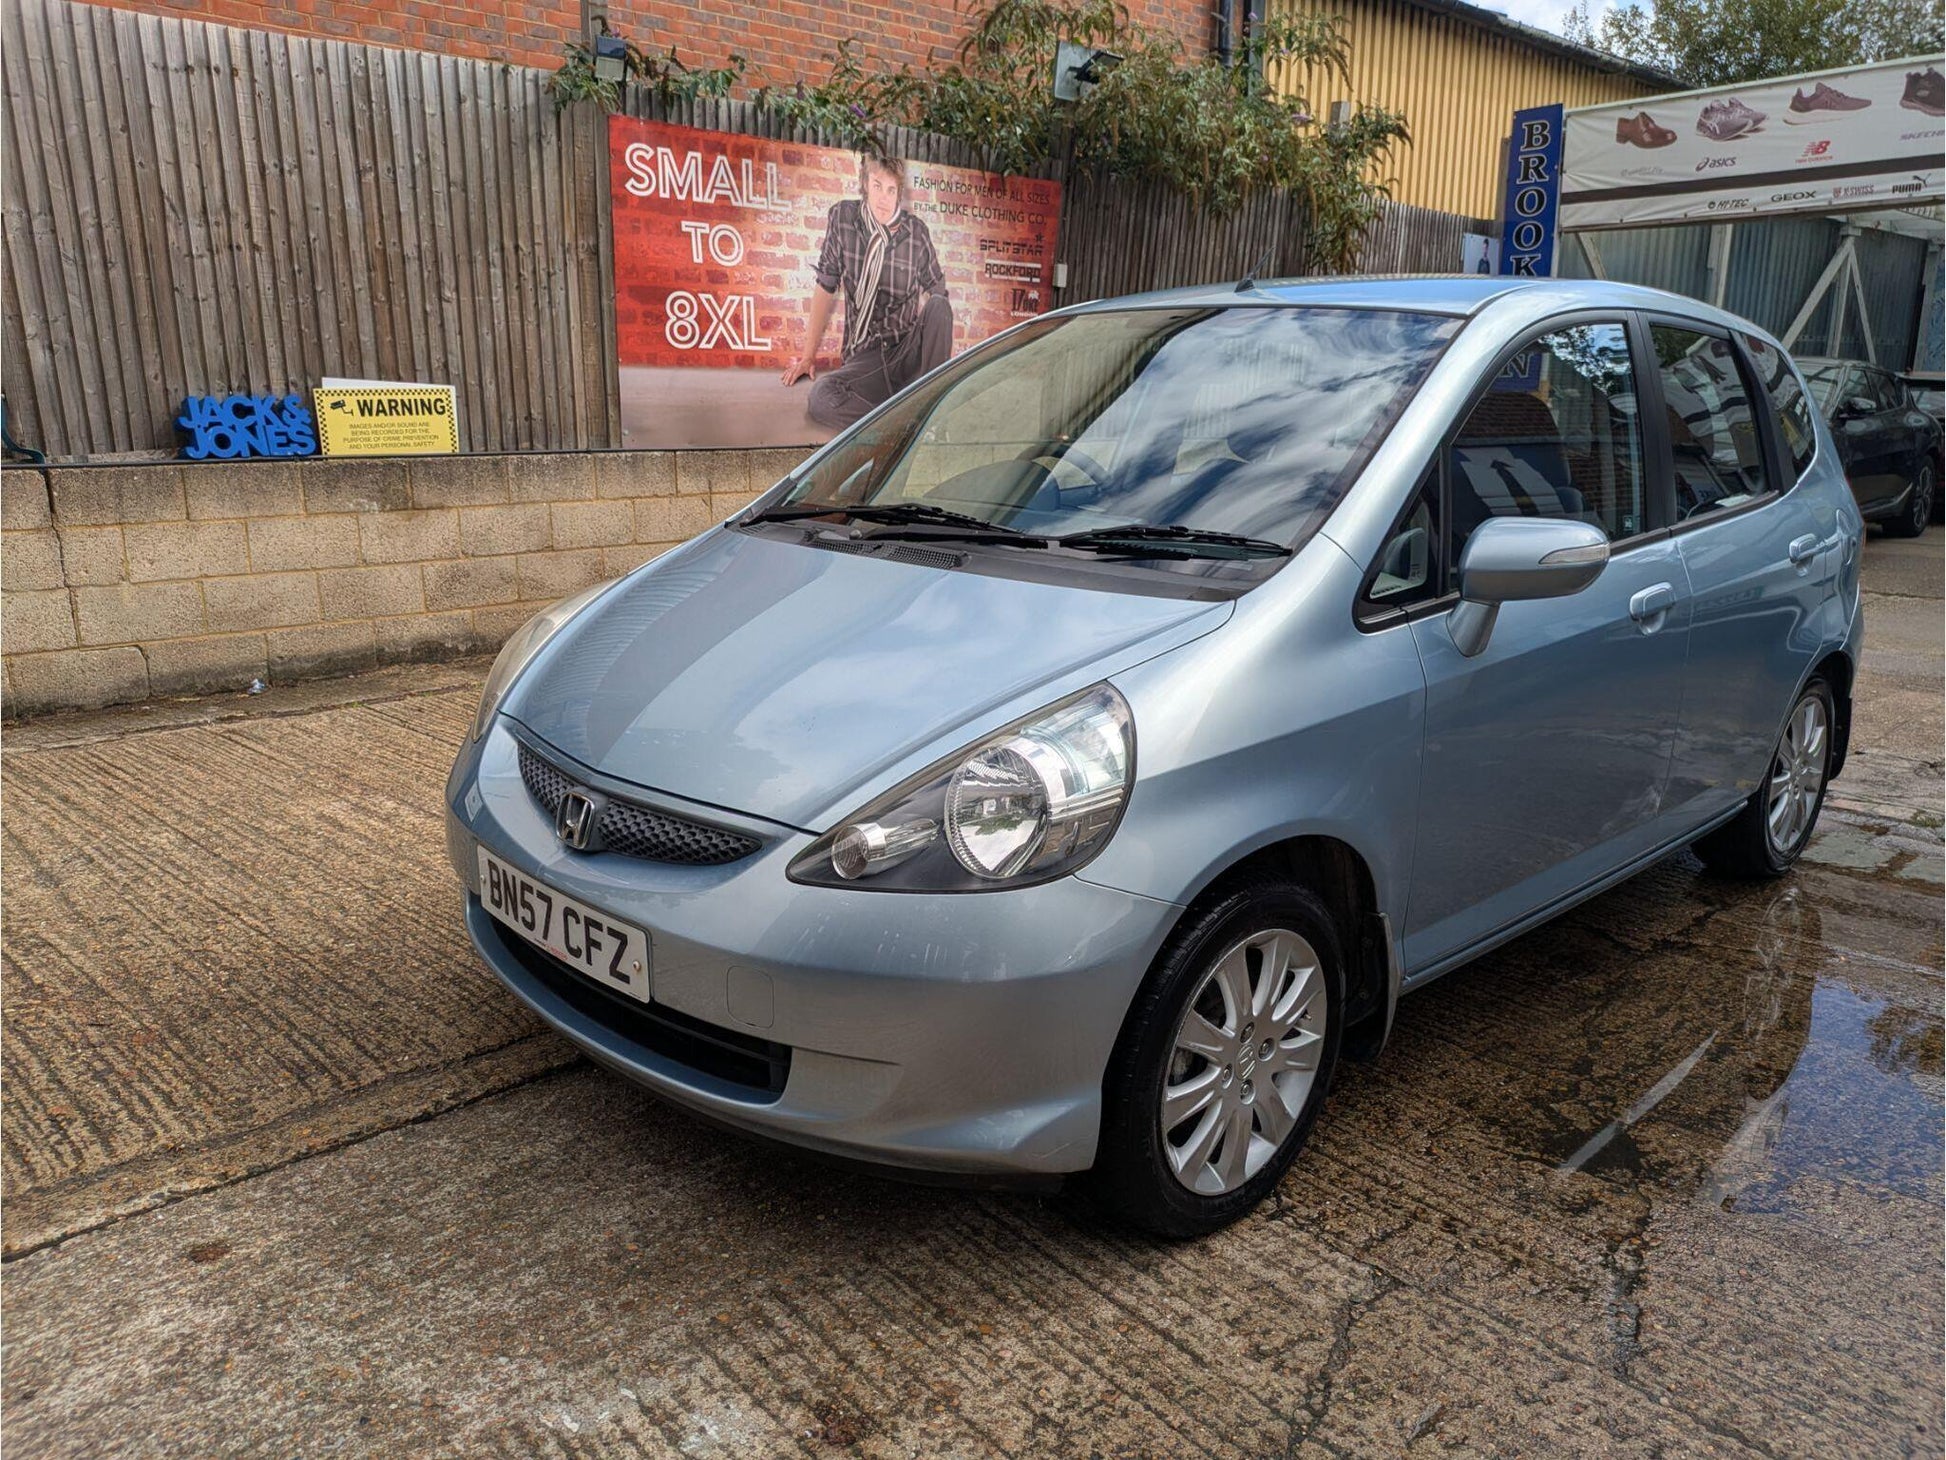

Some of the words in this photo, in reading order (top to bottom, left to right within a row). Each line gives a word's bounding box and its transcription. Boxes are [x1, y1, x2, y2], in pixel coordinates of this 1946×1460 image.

[625, 142, 792, 212] SMALL
[914, 176, 952, 193] FASHION
[955, 182, 972, 196] FOR
[975, 185, 993, 199] MEN
[996, 187, 1008, 199] OF
[1010, 190, 1024, 202] ALL
[1027, 192, 1050, 205] SIZES
[1770, 190, 1817, 203] GEOX
[914, 201, 923, 211] BY
[924, 202, 937, 213] THE
[939, 201, 968, 217] DUKE
[971, 206, 1025, 223] CLOTHING
[1027, 212, 1048, 225] CO.
[681, 220, 744, 267] TO
[985, 262, 1041, 283] ROCKFORD
[665, 291, 772, 351] 8XL
[357, 398, 446, 417] WARNING
[185, 424, 316, 459] JONES
[487, 859, 553, 941] BN57
[563, 906, 631, 985] CFZ
